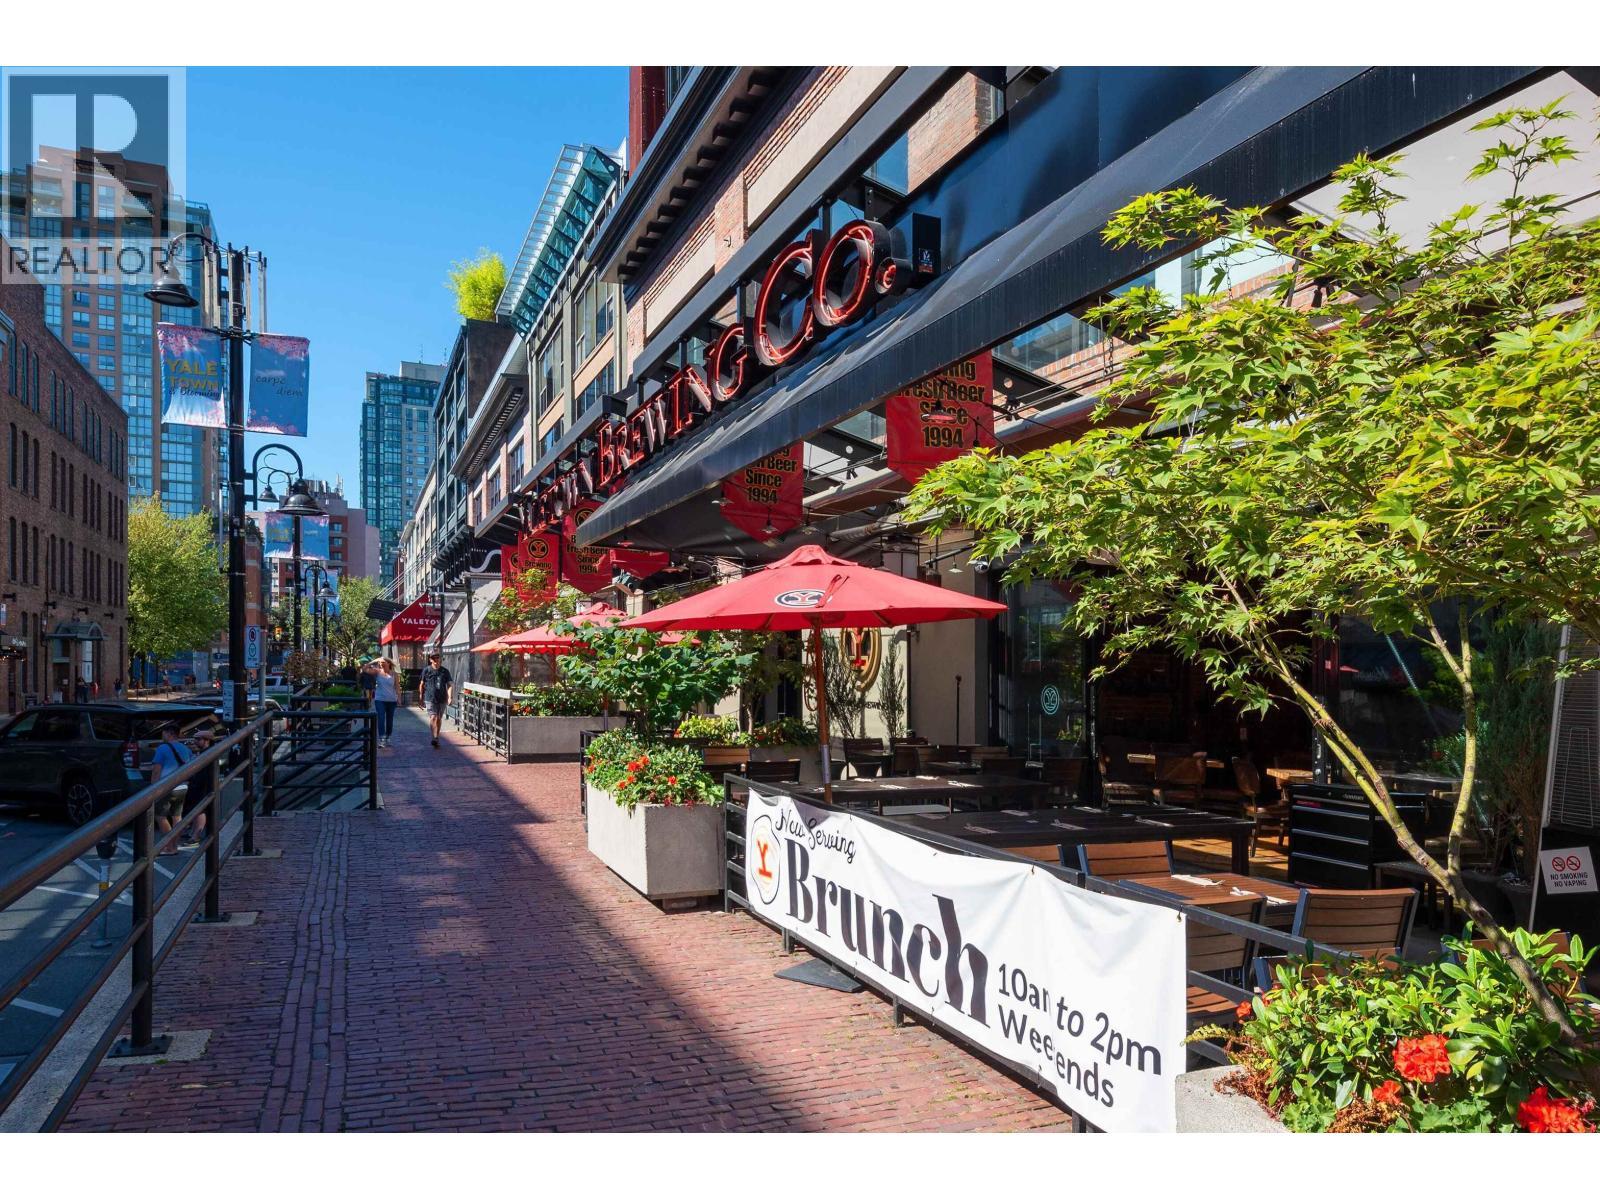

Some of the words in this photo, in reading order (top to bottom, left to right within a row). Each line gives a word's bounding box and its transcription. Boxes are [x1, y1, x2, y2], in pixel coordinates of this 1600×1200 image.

[598, 322, 748, 487] BREWING
[753, 219, 897, 367] CO.
[167, 359, 218, 375] YALE
[170, 376, 219, 391] TOWN
[922, 426, 964, 448] 1994
[767, 456, 797, 472] Beer
[745, 468, 782, 488] Since
[747, 486, 778, 504] 1994
[807, 817, 856, 864] Serving
[1560, 871, 1588, 880] SMOKING
[1564, 879, 1587, 887] VAPING
[784, 837, 991, 1028] Brunch
[1056, 996, 1084, 1037] to
[1090, 1011, 1162, 1076] 2pm
[997, 1004, 1114, 1108] Weeends
